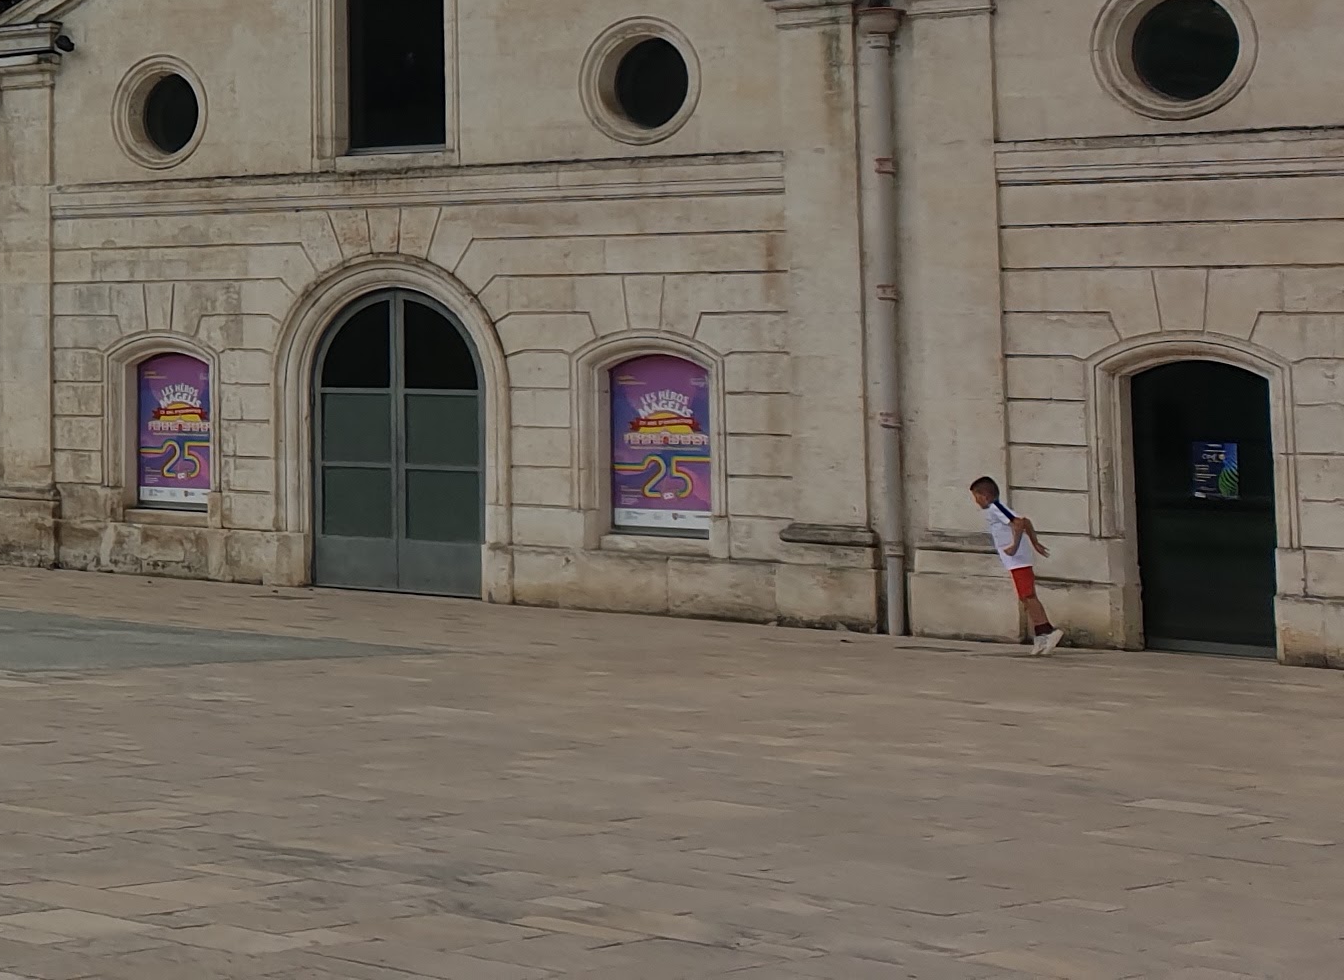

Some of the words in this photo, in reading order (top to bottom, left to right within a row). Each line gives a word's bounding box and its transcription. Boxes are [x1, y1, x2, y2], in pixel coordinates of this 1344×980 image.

[161, 385, 174, 397] LES
[640, 391, 657, 405] LES
[159, 392, 202, 409] MAGELIS
[638, 400, 694, 420] MAGELIS
[161, 439, 201, 479] 25
[642, 454, 693, 499] 25
